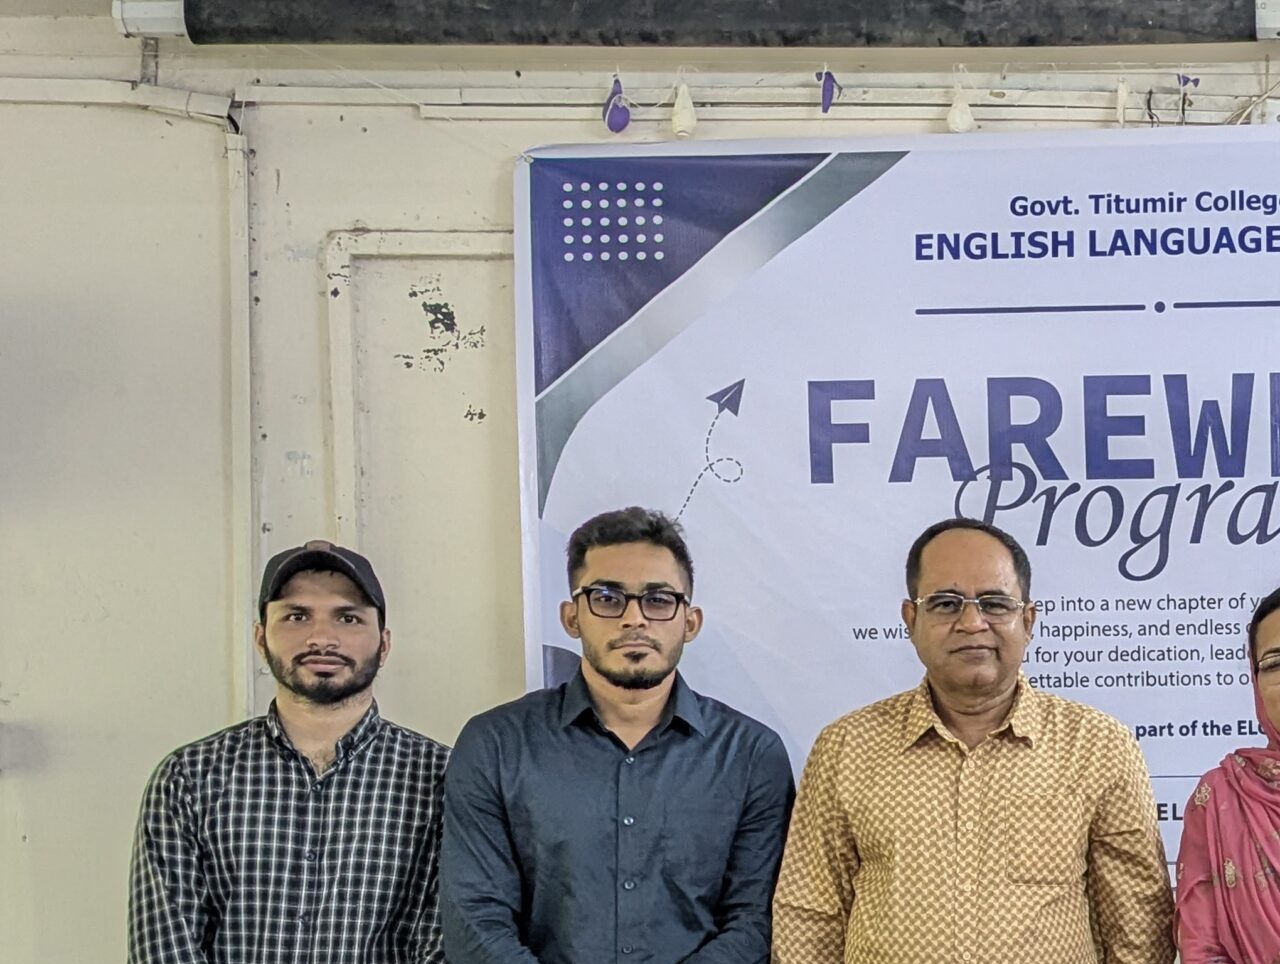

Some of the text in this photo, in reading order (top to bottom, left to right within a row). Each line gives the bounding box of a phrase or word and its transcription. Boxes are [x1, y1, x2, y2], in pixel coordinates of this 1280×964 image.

[1009, 195, 1080, 217] Govt.
[1089, 192, 1187, 215] Titumir
[914, 230, 1075, 261] ENGLISH
[1060, 596, 1096, 612] into
[1100, 598, 1110, 612] a
[1115, 598, 1151, 611] new
[1156, 594, 1224, 614] chapter
[1228, 592, 1247, 609] of
[852, 627, 879, 640] we
[882, 623, 912, 640] wis
[1040, 621, 1133, 641] happiness,
[1137, 619, 1171, 637] and
[1175, 618, 1241, 636] endless
[1034, 646, 1060, 663] for
[1063, 649, 1104, 667] your
[1108, 645, 1205, 664] dedication,
[1095, 670, 1212, 688] contributions
[1216, 671, 1234, 686] to
[1135, 722, 1175, 741] part
[1179, 720, 1199, 736] of
[1202, 720, 1232, 736] the
